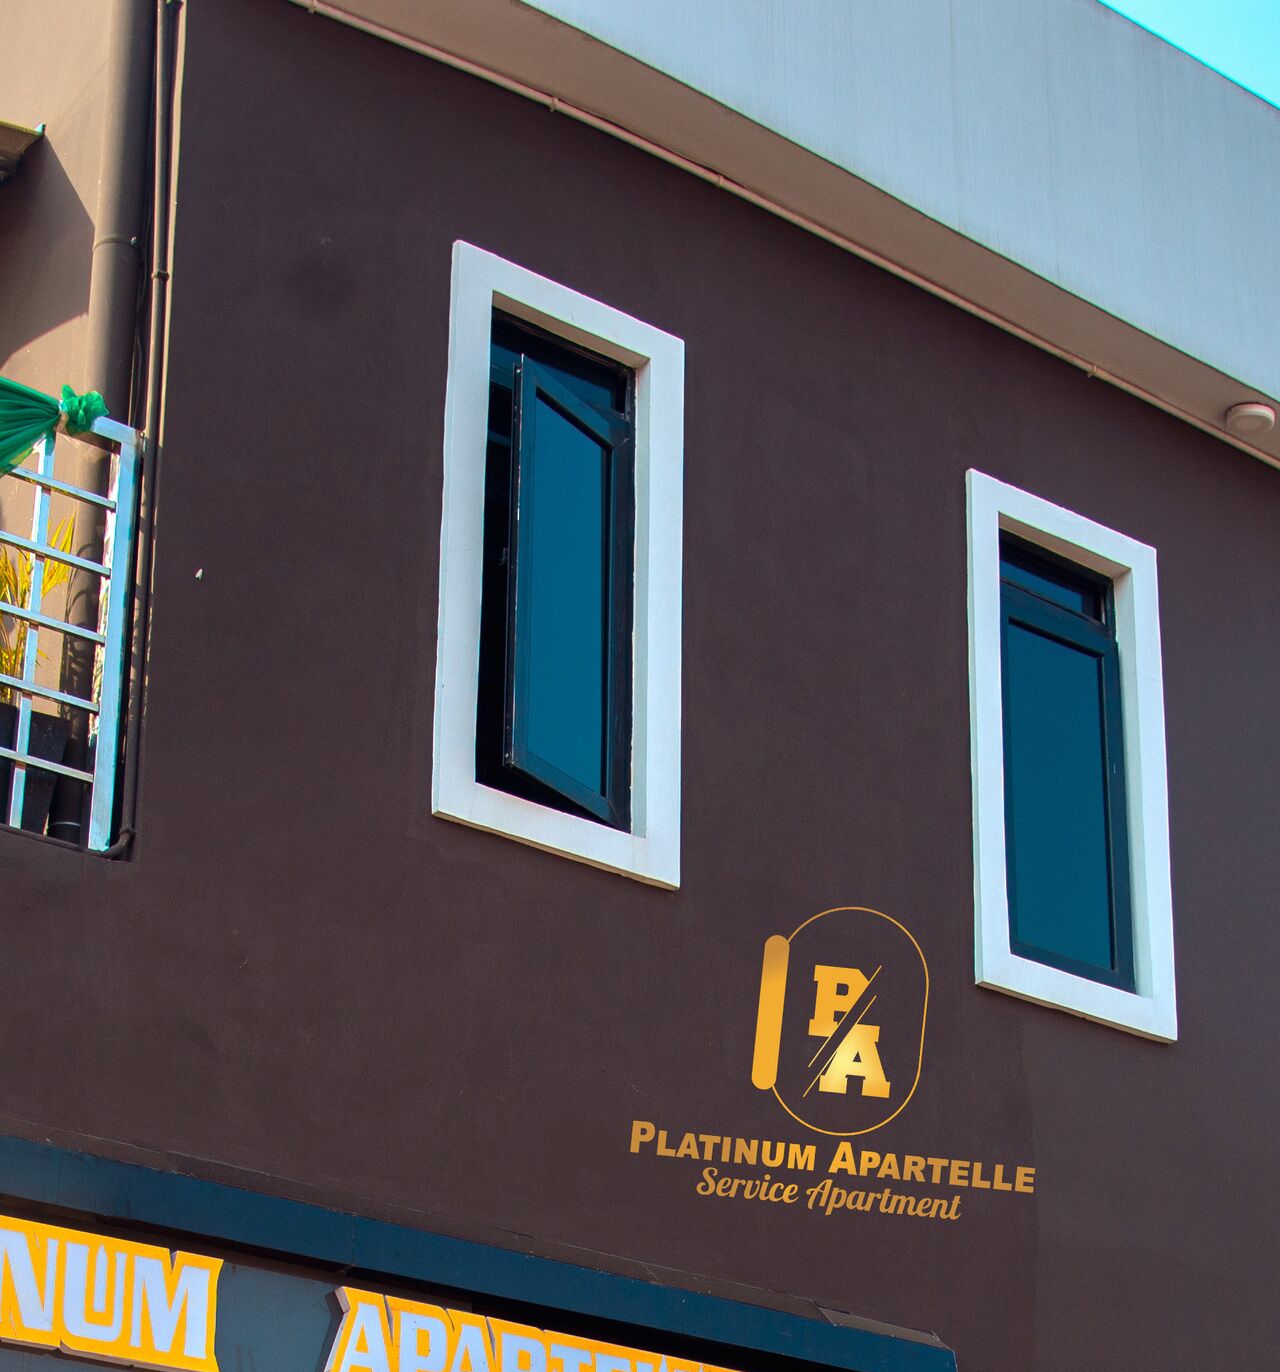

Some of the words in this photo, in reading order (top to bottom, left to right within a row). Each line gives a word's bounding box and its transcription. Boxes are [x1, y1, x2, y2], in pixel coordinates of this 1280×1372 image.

[629, 1120, 816, 1171] PLATINUM
[829, 1141, 1036, 1193] APARTELLE
[696, 1167, 799, 1205] Service
[806, 1180, 962, 1221] Apartment
